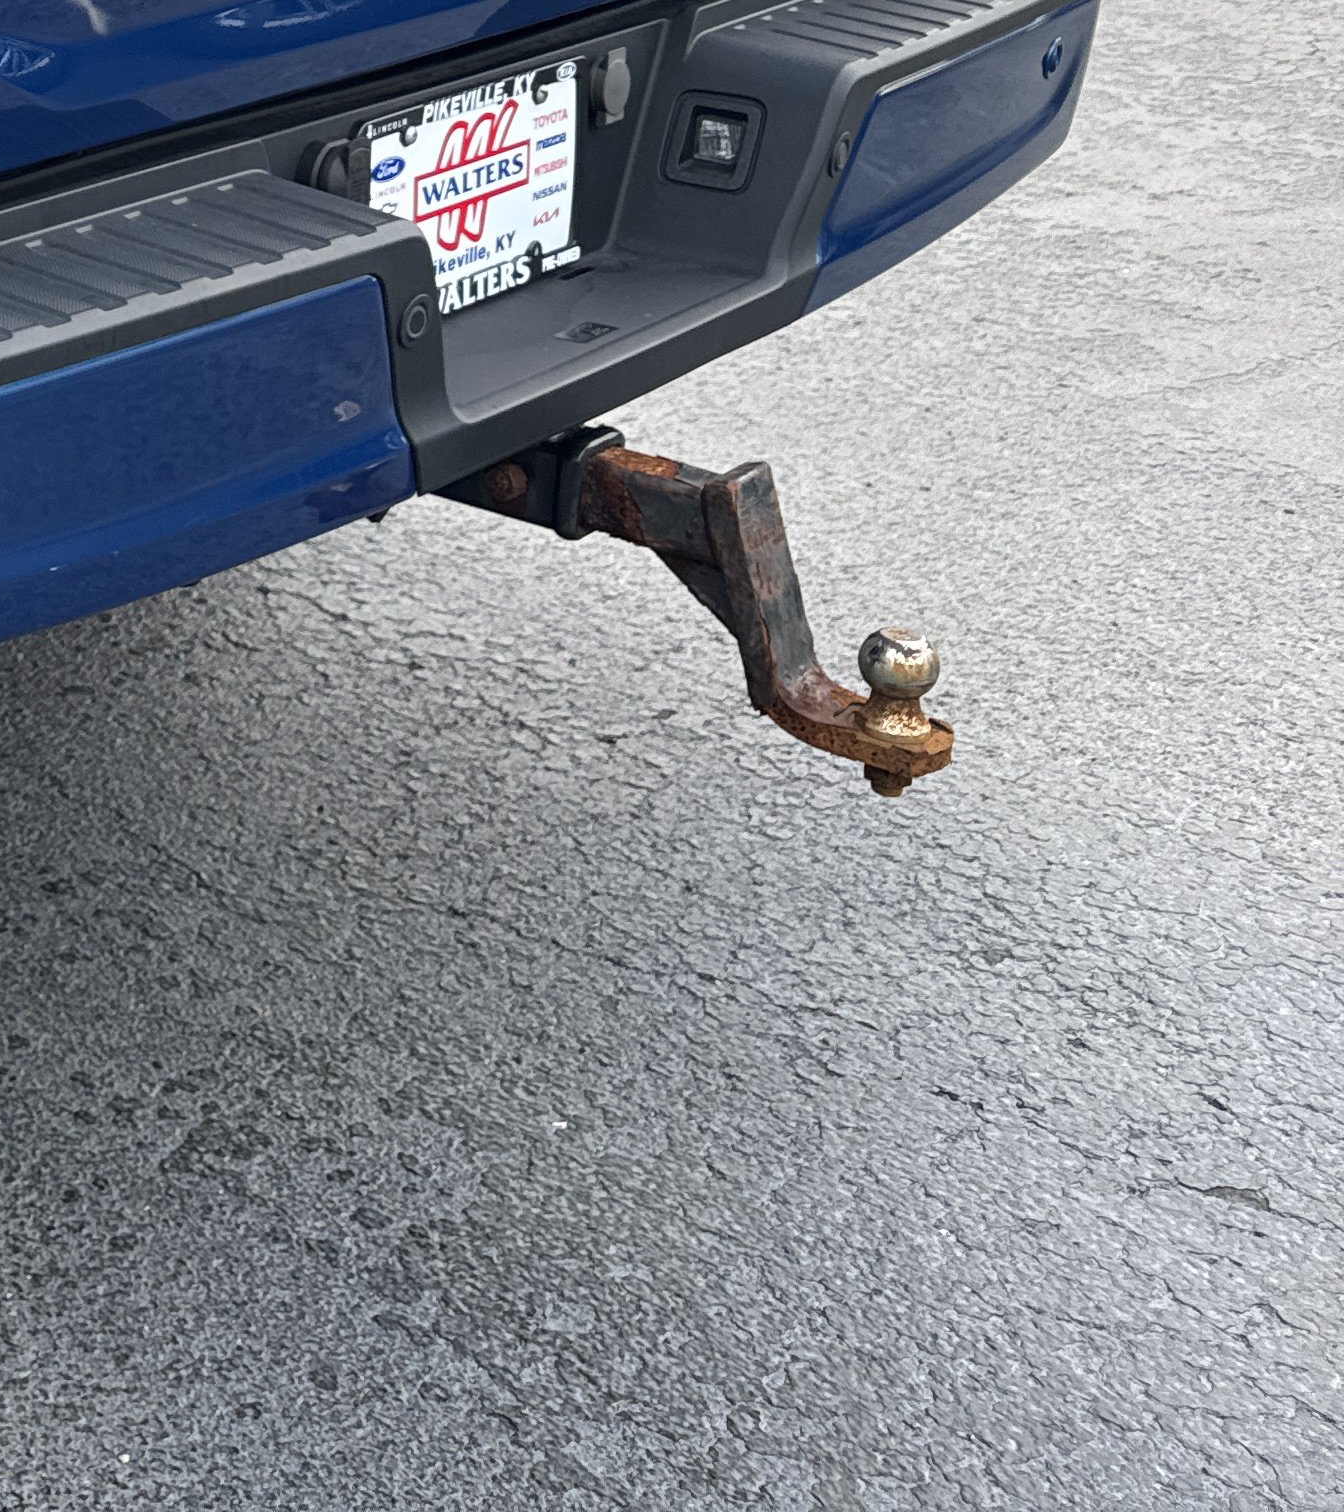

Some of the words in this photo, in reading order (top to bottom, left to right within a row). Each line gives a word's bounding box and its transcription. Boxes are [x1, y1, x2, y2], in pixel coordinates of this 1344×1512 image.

[512, 72, 537, 97] KY
[533, 108, 568, 129] TOYOTA
[422, 153, 524, 205] WALTERS
[532, 181, 567, 201] NISSAN
[495, 230, 516, 254] KY
